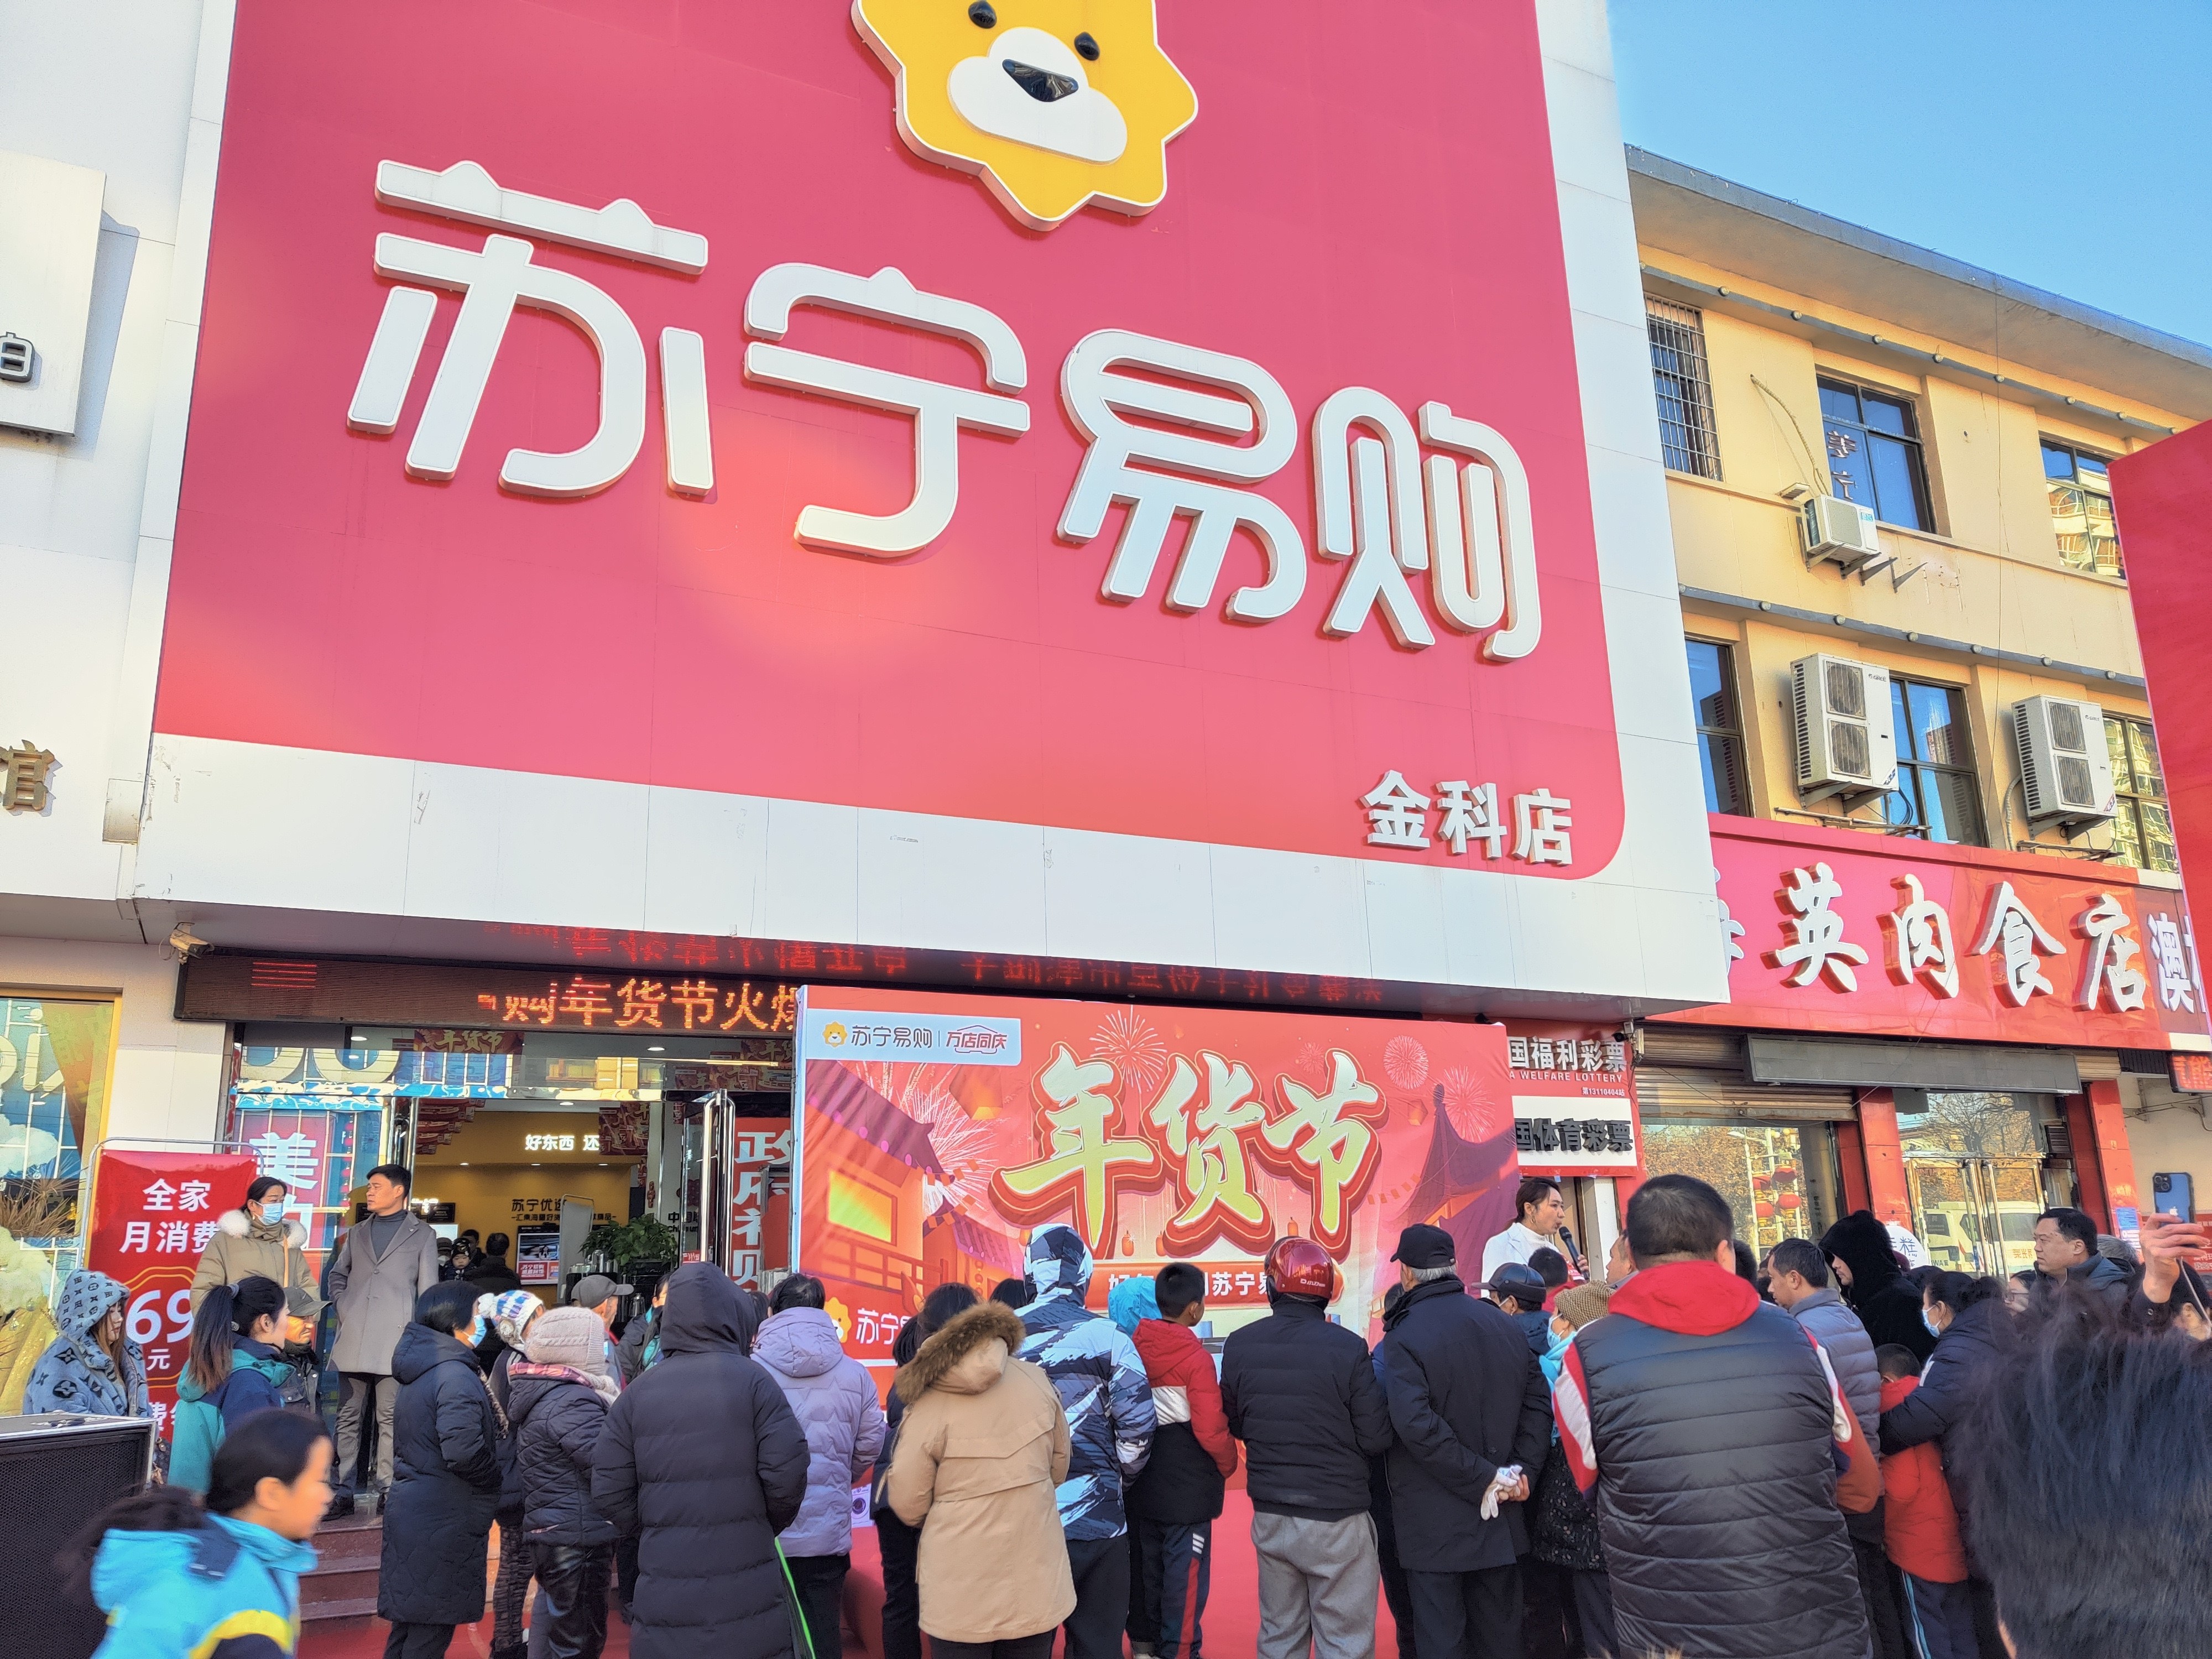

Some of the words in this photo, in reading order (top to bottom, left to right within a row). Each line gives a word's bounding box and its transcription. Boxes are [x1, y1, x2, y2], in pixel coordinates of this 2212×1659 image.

[347, 159, 1543, 664] 苏宁易购
[1358, 770, 1573, 866] 金科店
[1714, 862, 2146, 1013] 英肉食店
[2147, 912, 2206, 1014] 澳
[851, 1026, 932, 1048] 苏宁易购
[946, 1031, 1008, 1050] 万店同庆
[1508, 1036, 1627, 1072] 国福利彩票
[1521, 1071, 1571, 1081] WELFARE
[1575, 1073, 1622, 1083] LOTTERY
[1582, 1087, 1625, 1097] 第13110404站
[525, 1134, 575, 1151] 好东西
[995, 1041, 1385, 1255] 年货节
[1515, 1118, 1633, 1151] 国体育彩票
[142, 1178, 211, 1212] 全家
[119, 1220, 220, 1254] 月消费
[126, 1288, 194, 1344] 69
[147, 1348, 171, 1371] 元
